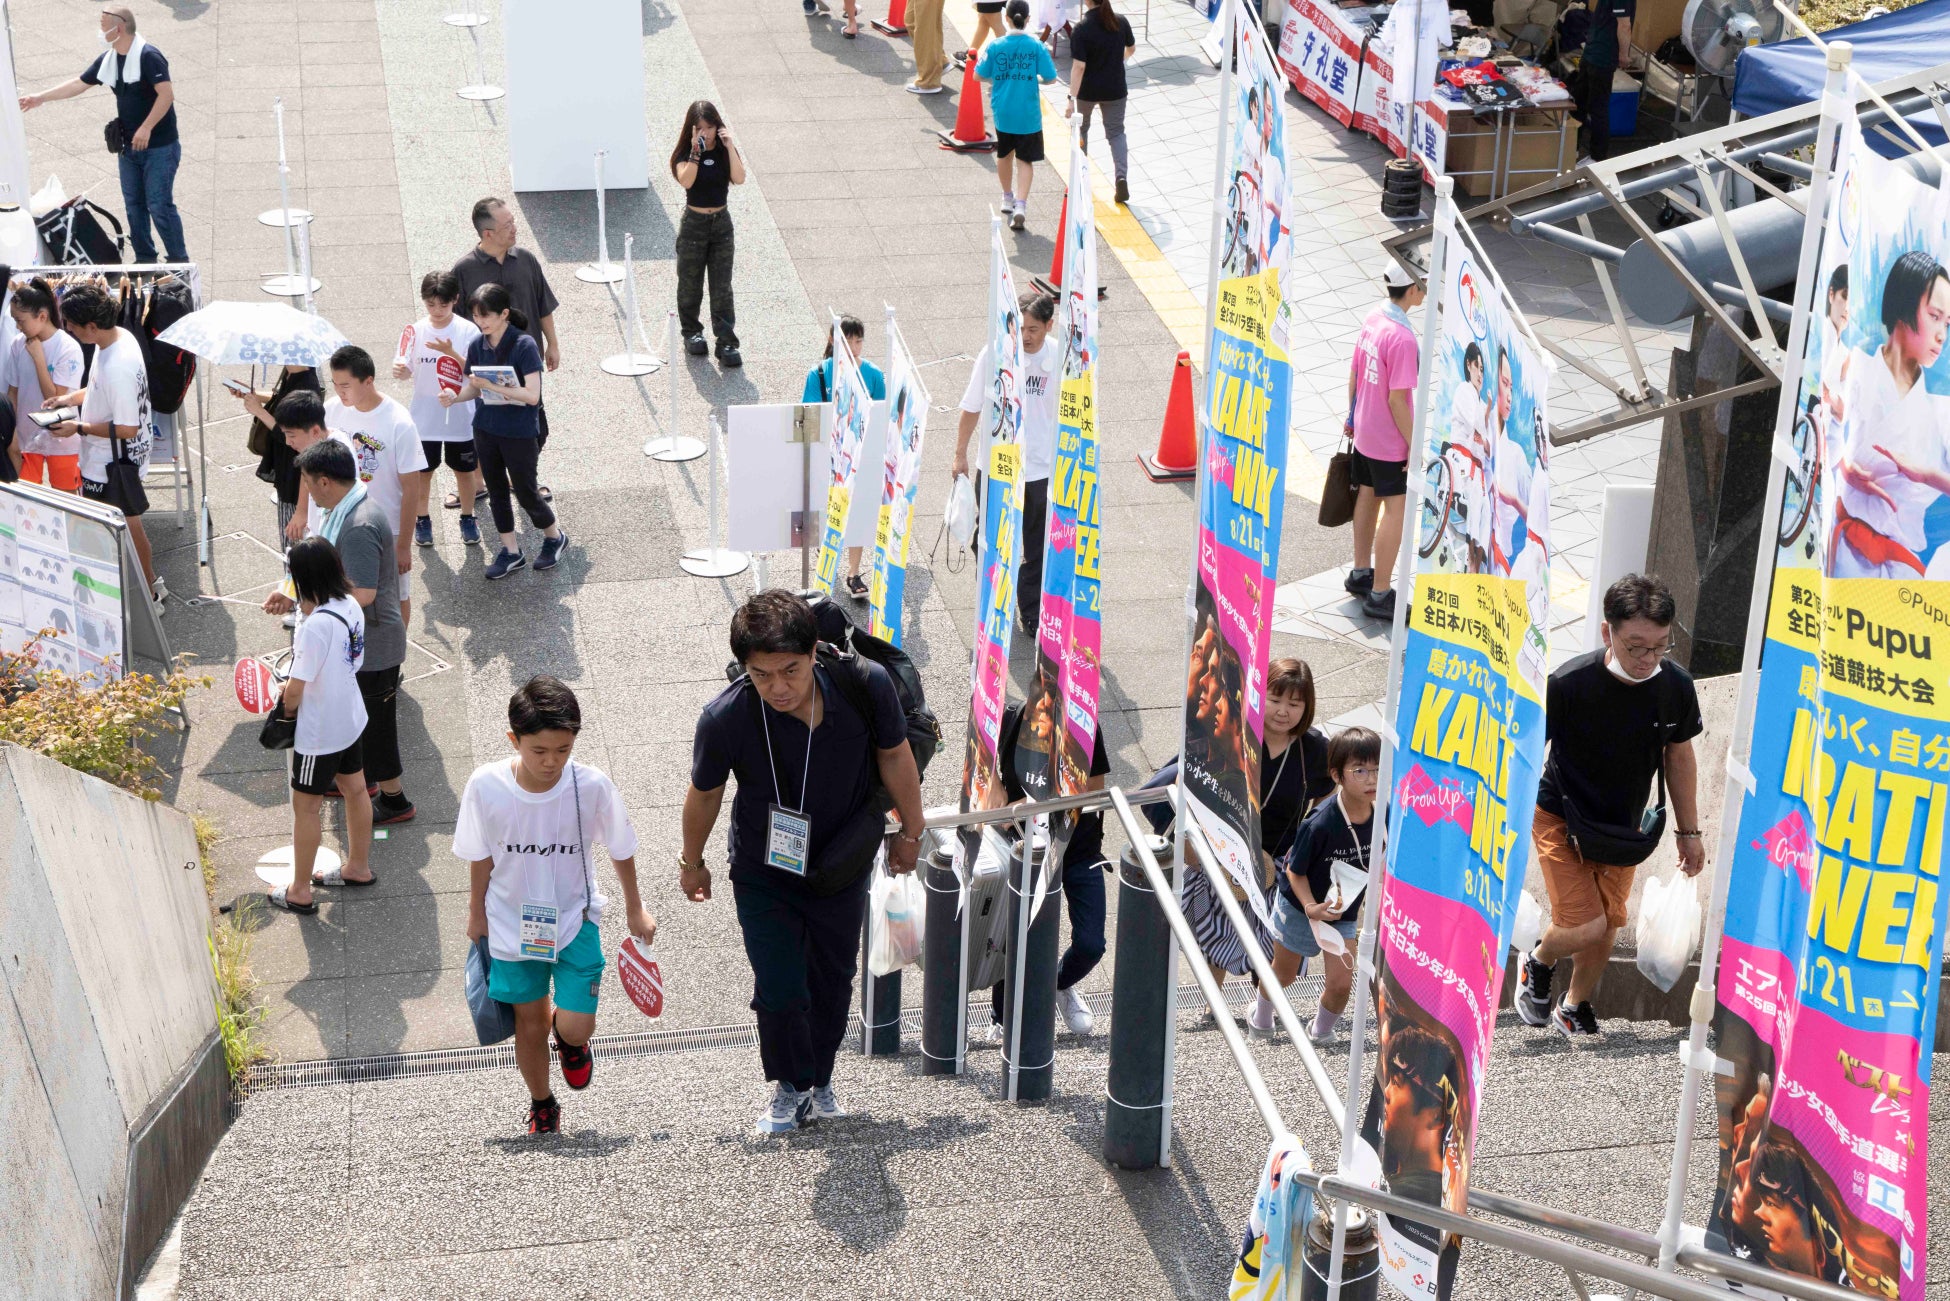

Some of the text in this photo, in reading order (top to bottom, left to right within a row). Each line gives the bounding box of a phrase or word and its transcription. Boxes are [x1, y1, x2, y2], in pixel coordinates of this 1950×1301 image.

[1427, 586, 1459, 610] 第21回
[1846, 607, 1932, 661] Pupu
[1025, 771, 1047, 788] 日本
[506, 843, 579, 857] HAYATE
[1465, 867, 1490, 913] 8/21
[1778, 1064, 1908, 1178] 少女空手道選
